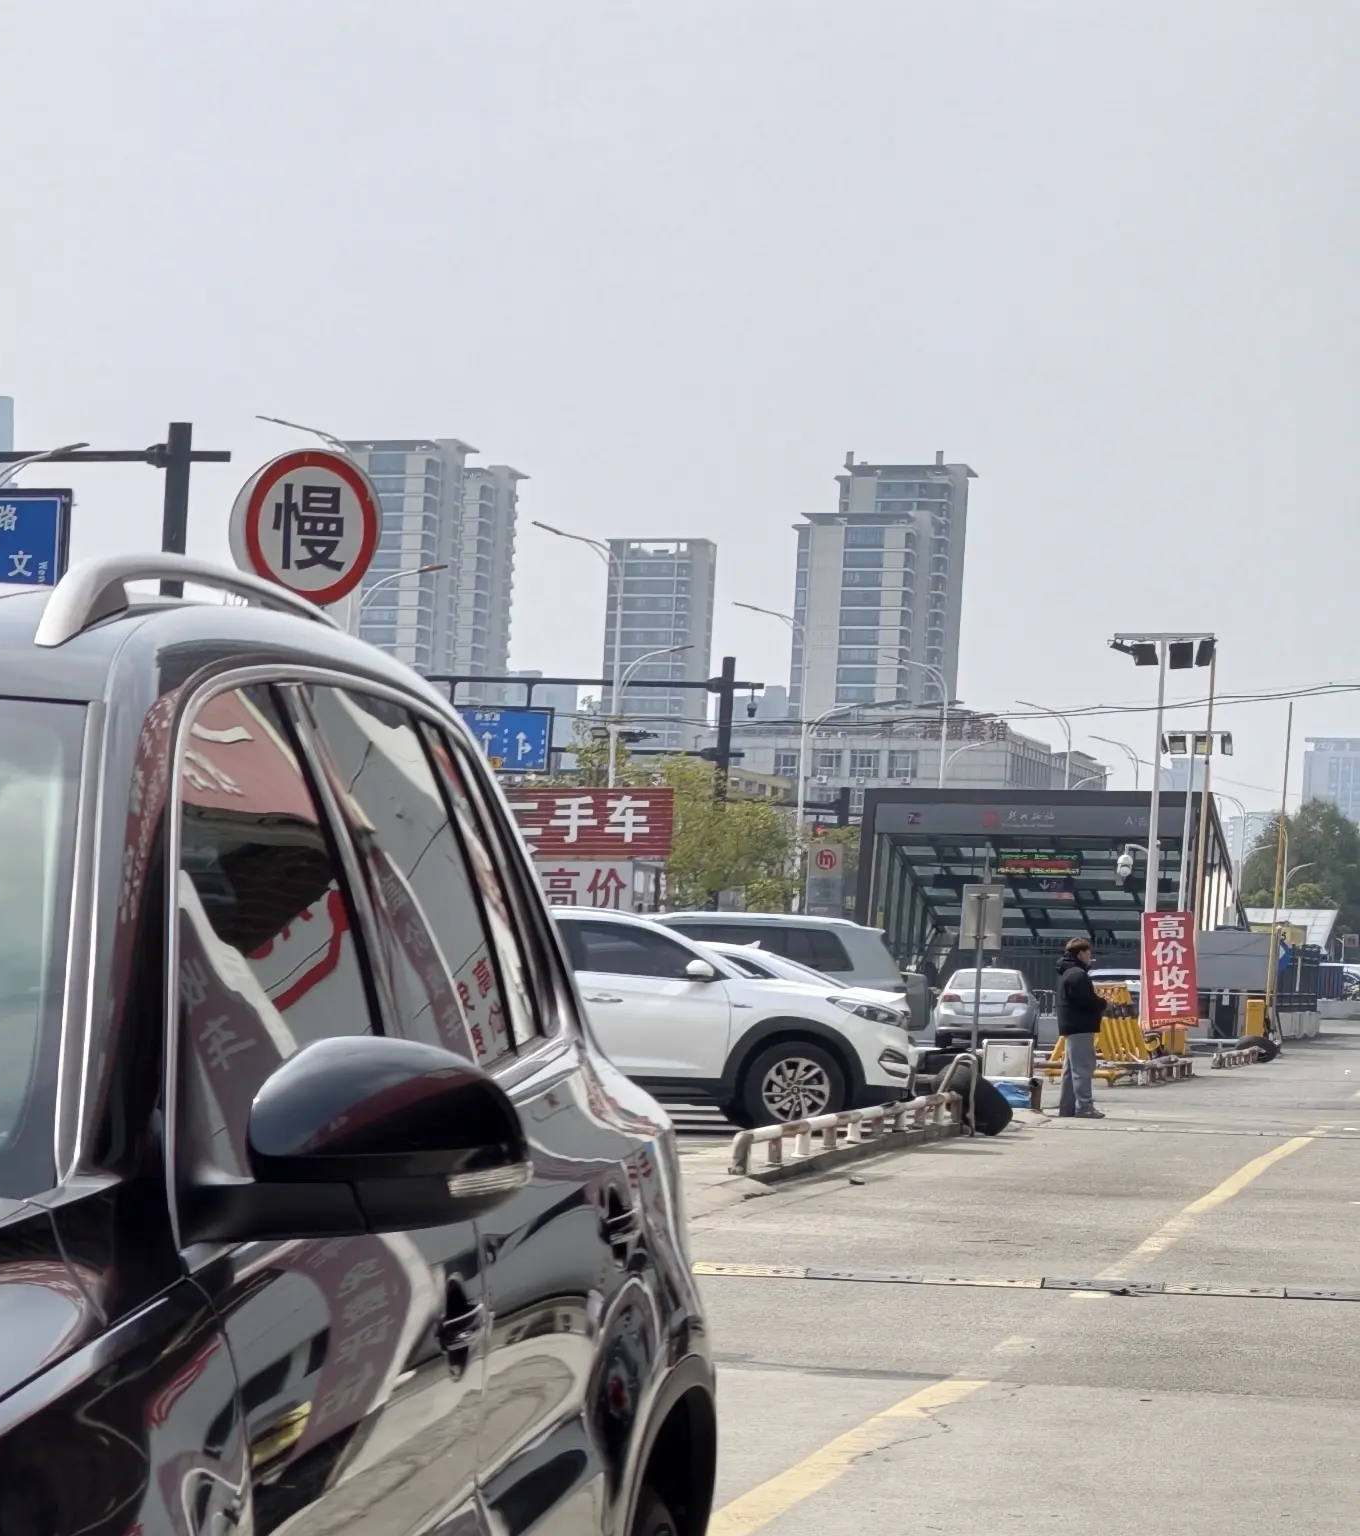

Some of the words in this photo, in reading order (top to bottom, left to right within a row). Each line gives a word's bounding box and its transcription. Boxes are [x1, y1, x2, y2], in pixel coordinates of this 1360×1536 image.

[272, 483, 346, 572] 慢
[7, 550, 33, 577] 文
[509, 795, 651, 843] 二手车
[541, 868, 628, 910] 高价
[1149, 915, 1191, 1016] 高价收车
